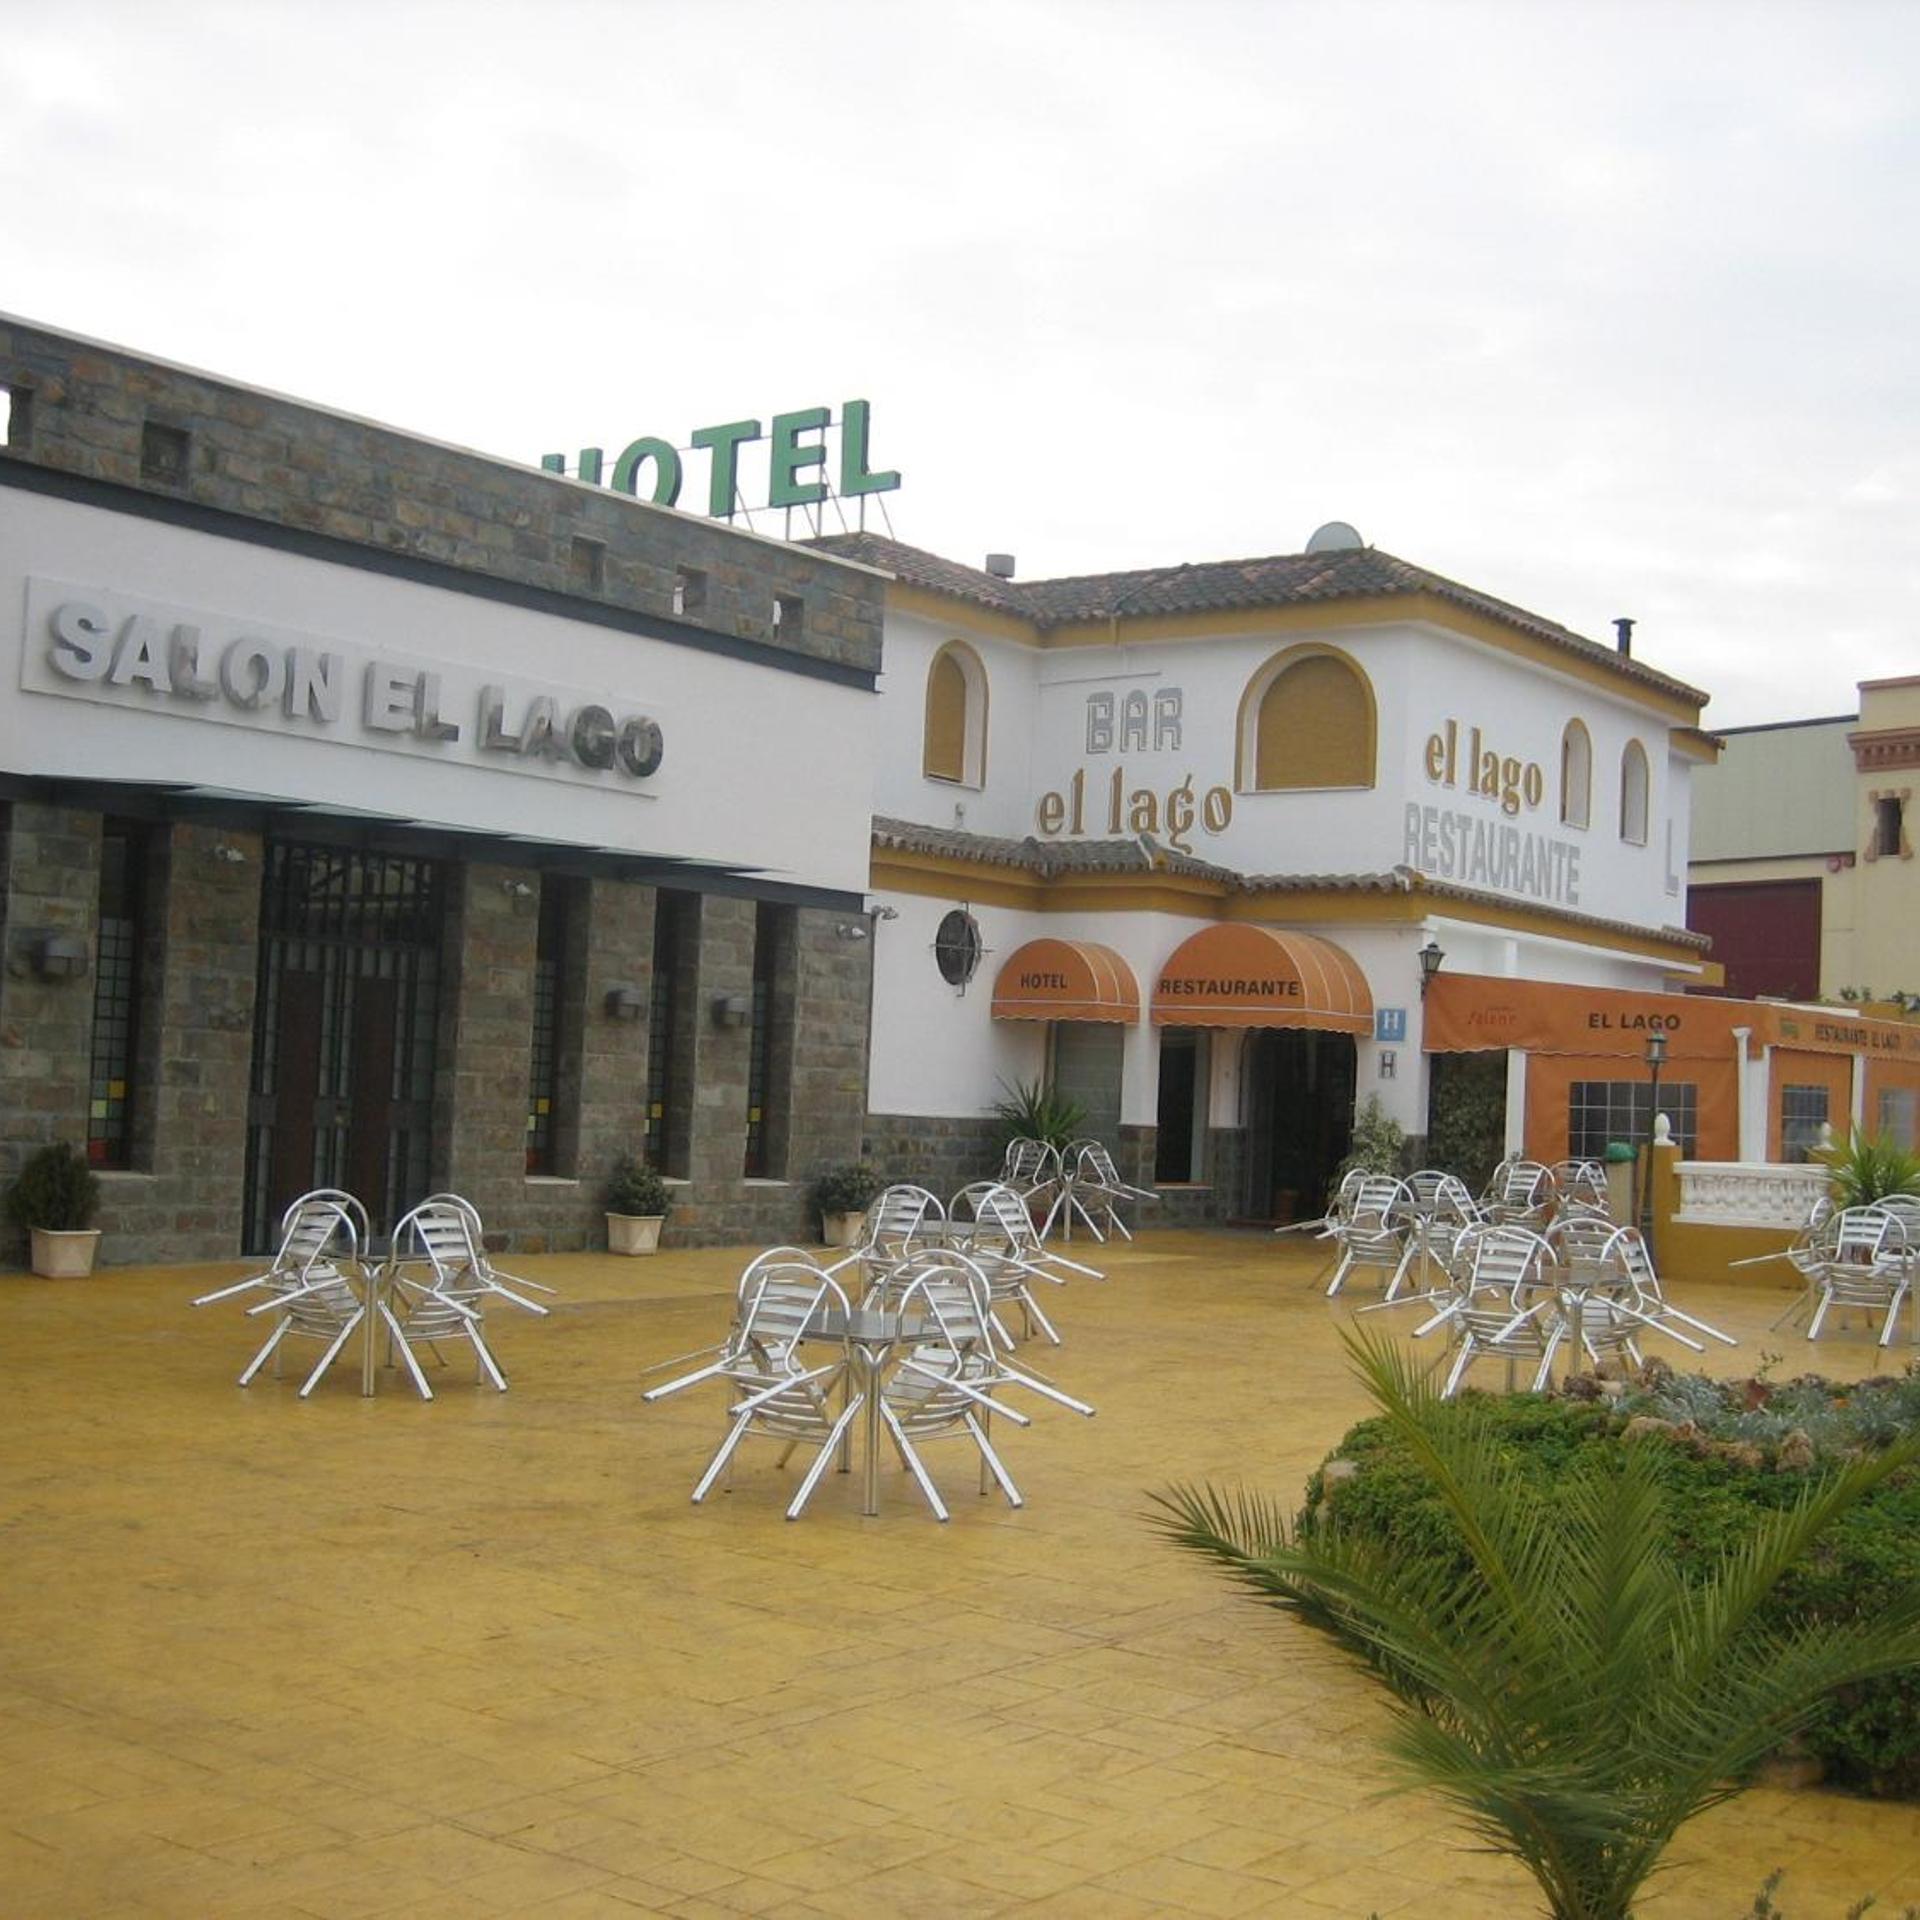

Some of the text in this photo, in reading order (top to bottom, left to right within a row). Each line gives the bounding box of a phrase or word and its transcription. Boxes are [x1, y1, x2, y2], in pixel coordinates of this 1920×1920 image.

[48, 602, 664, 778] SALON EL LAGO
[1086, 687, 1183, 755] BAR
[1425, 718, 1543, 817] el lago
[1037, 765, 1233, 855] el lago
[1403, 802, 1581, 906] RESTAURANTE
[1020, 973, 1068, 990] HOTEL
[1159, 978, 1299, 997] RESTAURANTE
[1588, 1012, 1681, 1031] EL LAGO
